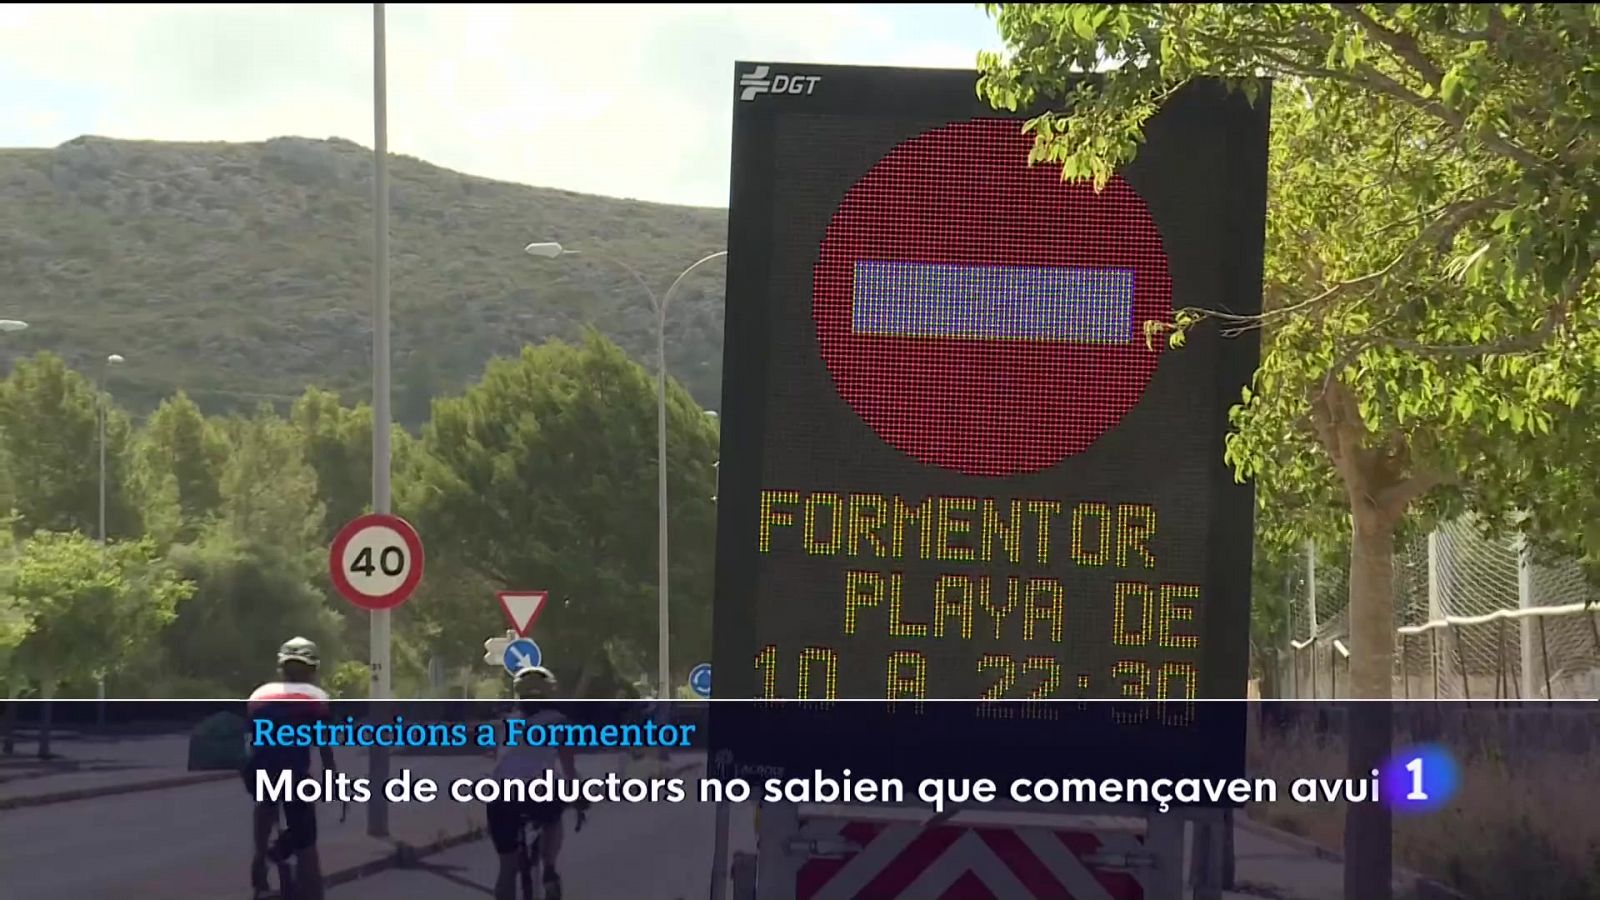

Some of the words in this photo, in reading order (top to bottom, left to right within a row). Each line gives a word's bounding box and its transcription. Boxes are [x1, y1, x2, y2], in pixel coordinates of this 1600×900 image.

[771, 74, 821, 95] DGT
[350, 546, 404, 577] 40
[759, 489, 1157, 569] FORMENTOR
[844, 569, 1064, 642] PLAYA
[1113, 580, 1200, 648] DE
[754, 645, 838, 711] 10
[887, 649, 927, 715] A
[976, 653, 1197, 727] 22:30
